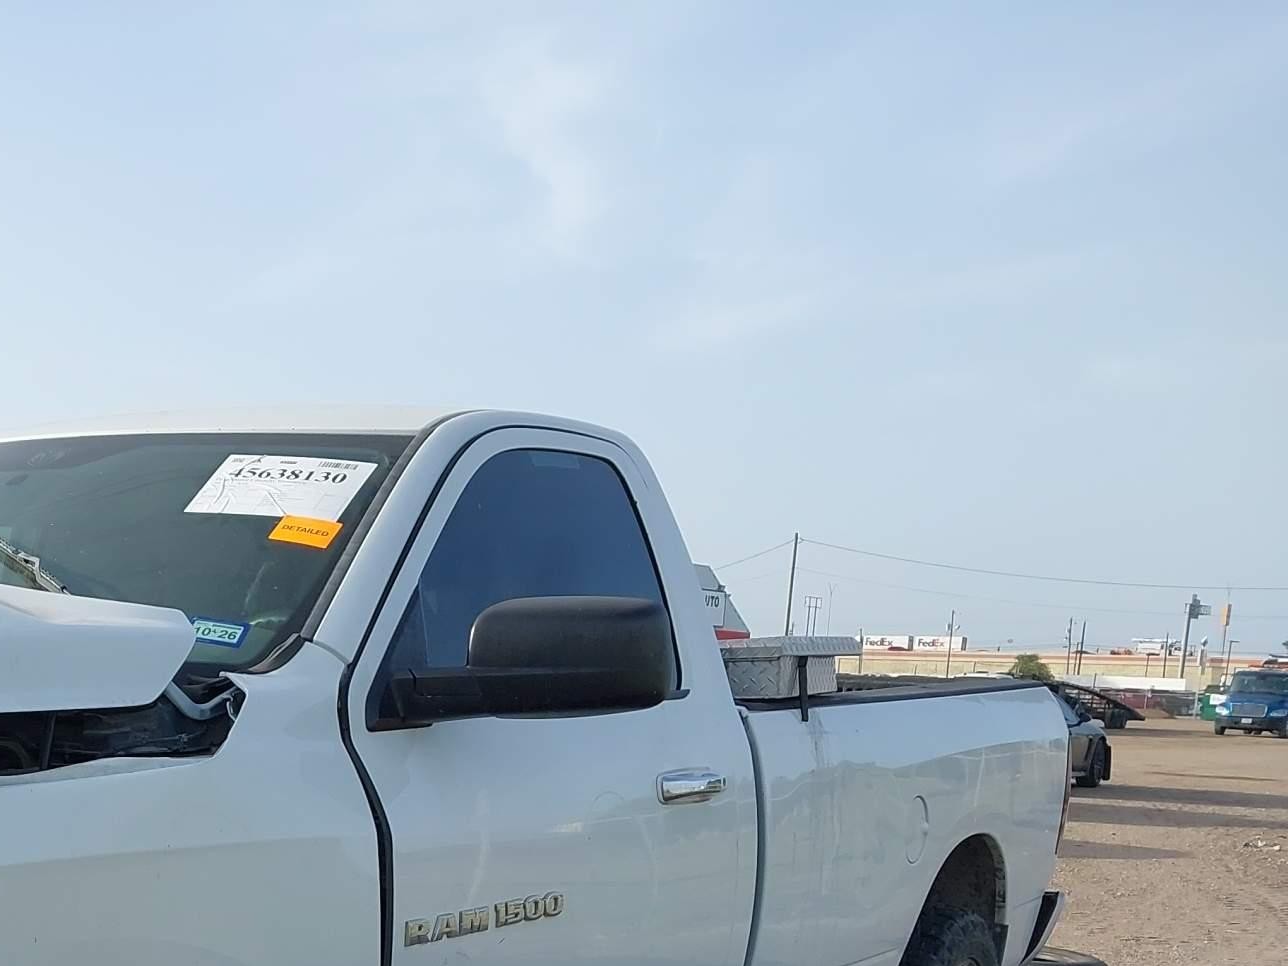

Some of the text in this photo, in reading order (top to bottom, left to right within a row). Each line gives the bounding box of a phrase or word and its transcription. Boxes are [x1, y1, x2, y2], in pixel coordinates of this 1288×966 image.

[229, 467, 348, 484] 45638130
[281, 523, 330, 538] DETAILED
[865, 637, 893, 647] FedEx
[918, 638, 944, 648] FedEx
[404, 891, 564, 948] RAM 1500
